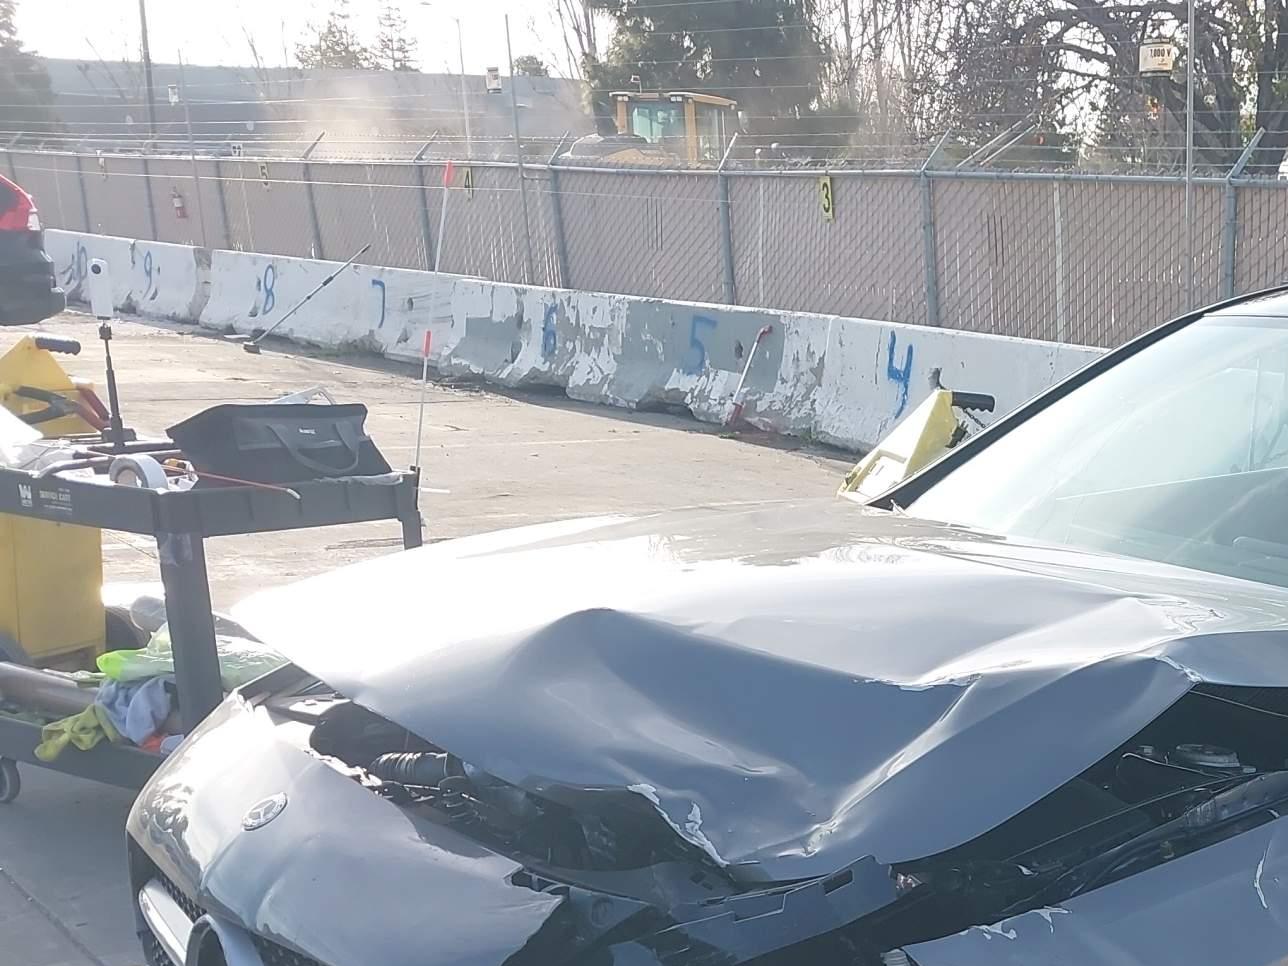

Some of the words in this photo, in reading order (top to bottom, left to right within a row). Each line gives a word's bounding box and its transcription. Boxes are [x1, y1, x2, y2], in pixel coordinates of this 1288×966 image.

[822, 182, 831, 213] 3
[143, 250, 153, 299] 9
[262, 264, 275, 315] 8
[371, 279, 385, 329] 7
[682, 314, 718, 375] 5
[887, 330, 914, 419] 4
